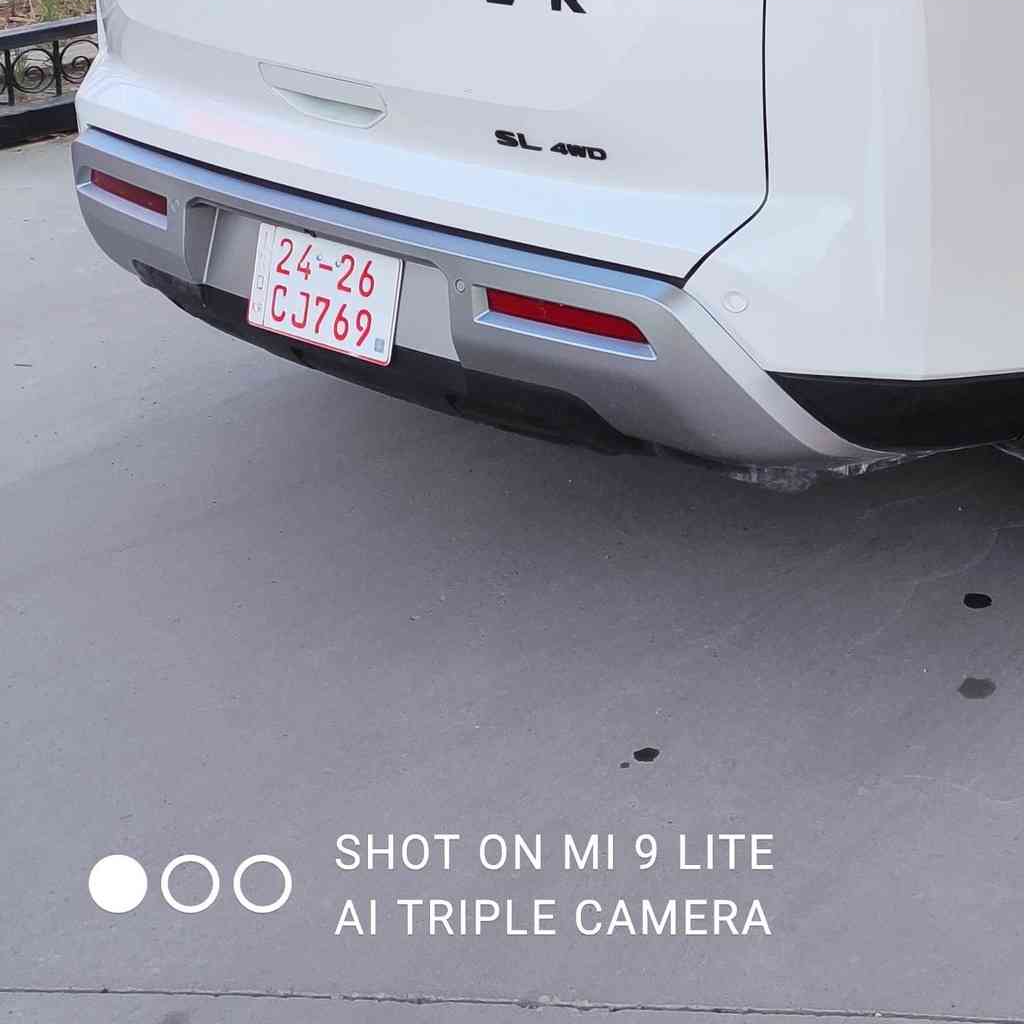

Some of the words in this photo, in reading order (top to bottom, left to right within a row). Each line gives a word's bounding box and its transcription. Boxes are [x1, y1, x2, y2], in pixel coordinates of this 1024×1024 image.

[494, 129, 543, 152] SL
[549, 142, 607, 161] 4WD
[275, 238, 375, 298] 24-26
[270, 284, 373, 347] CJ769
